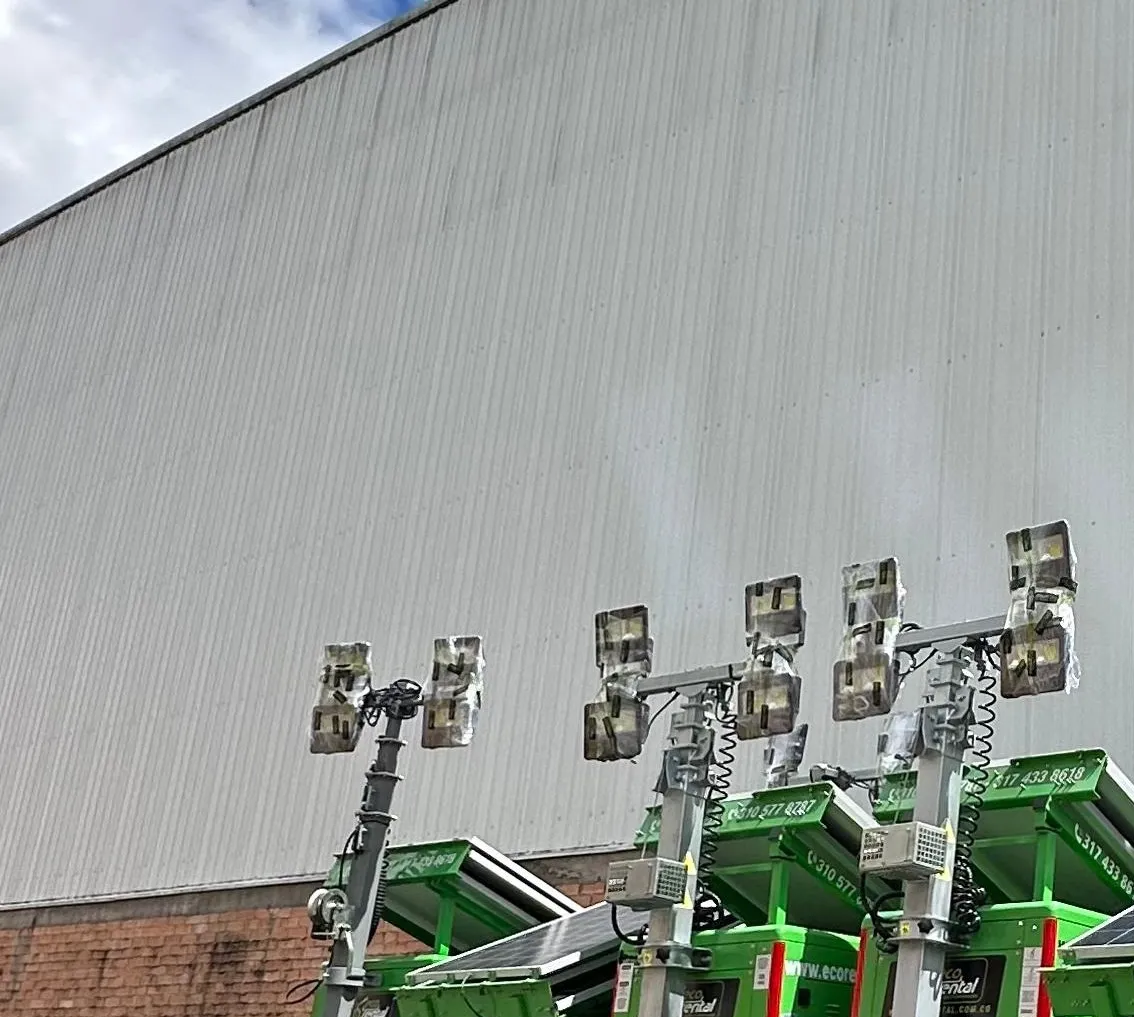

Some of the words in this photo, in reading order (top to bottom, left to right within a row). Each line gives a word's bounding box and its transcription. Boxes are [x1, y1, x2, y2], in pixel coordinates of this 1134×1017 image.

[1021, 770, 1048, 785] 433
[1049, 766, 1085, 783] 8618
[759, 803, 782, 817] 577
[1082, 832, 1103, 861] 317
[1101, 855, 1121, 880] 433
[815, 857, 834, 881] 310
[836, 875, 857, 897] 577
